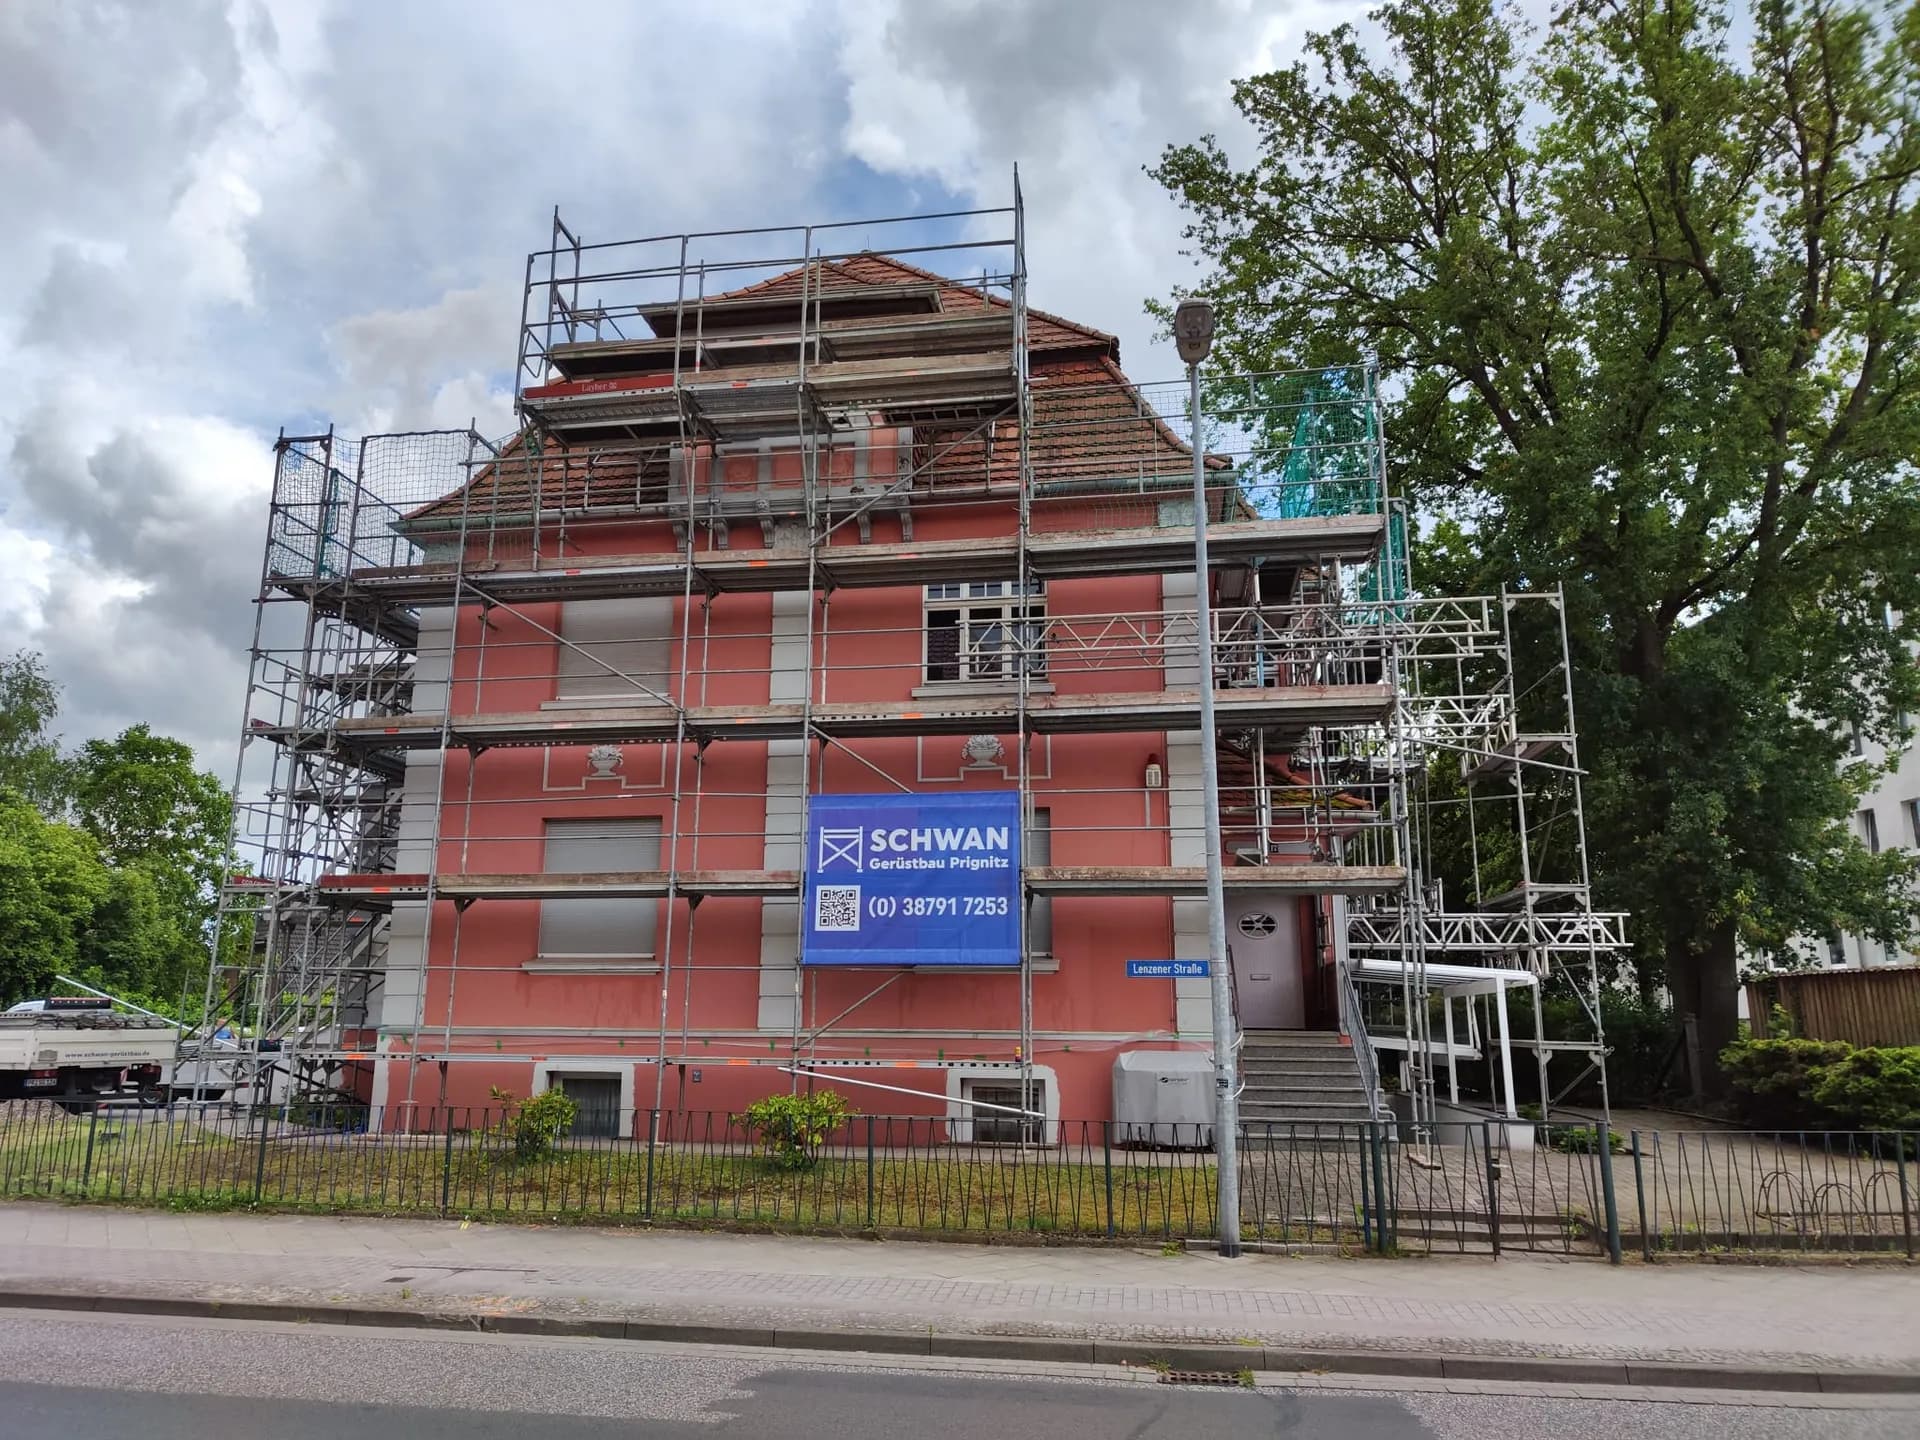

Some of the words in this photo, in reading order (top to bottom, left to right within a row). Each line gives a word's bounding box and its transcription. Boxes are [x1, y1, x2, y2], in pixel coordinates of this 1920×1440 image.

[870, 827, 1009, 852] SCHWAN
[869, 857, 945, 870] Gerüstbau
[949, 856, 1009, 871] Prignitz
[868, 896, 897, 918] (0)
[902, 897, 957, 916] 38791
[963, 897, 1008, 915] 7253
[1133, 963, 1172, 974] Lenzener
[1174, 963, 1203, 974] Straße
